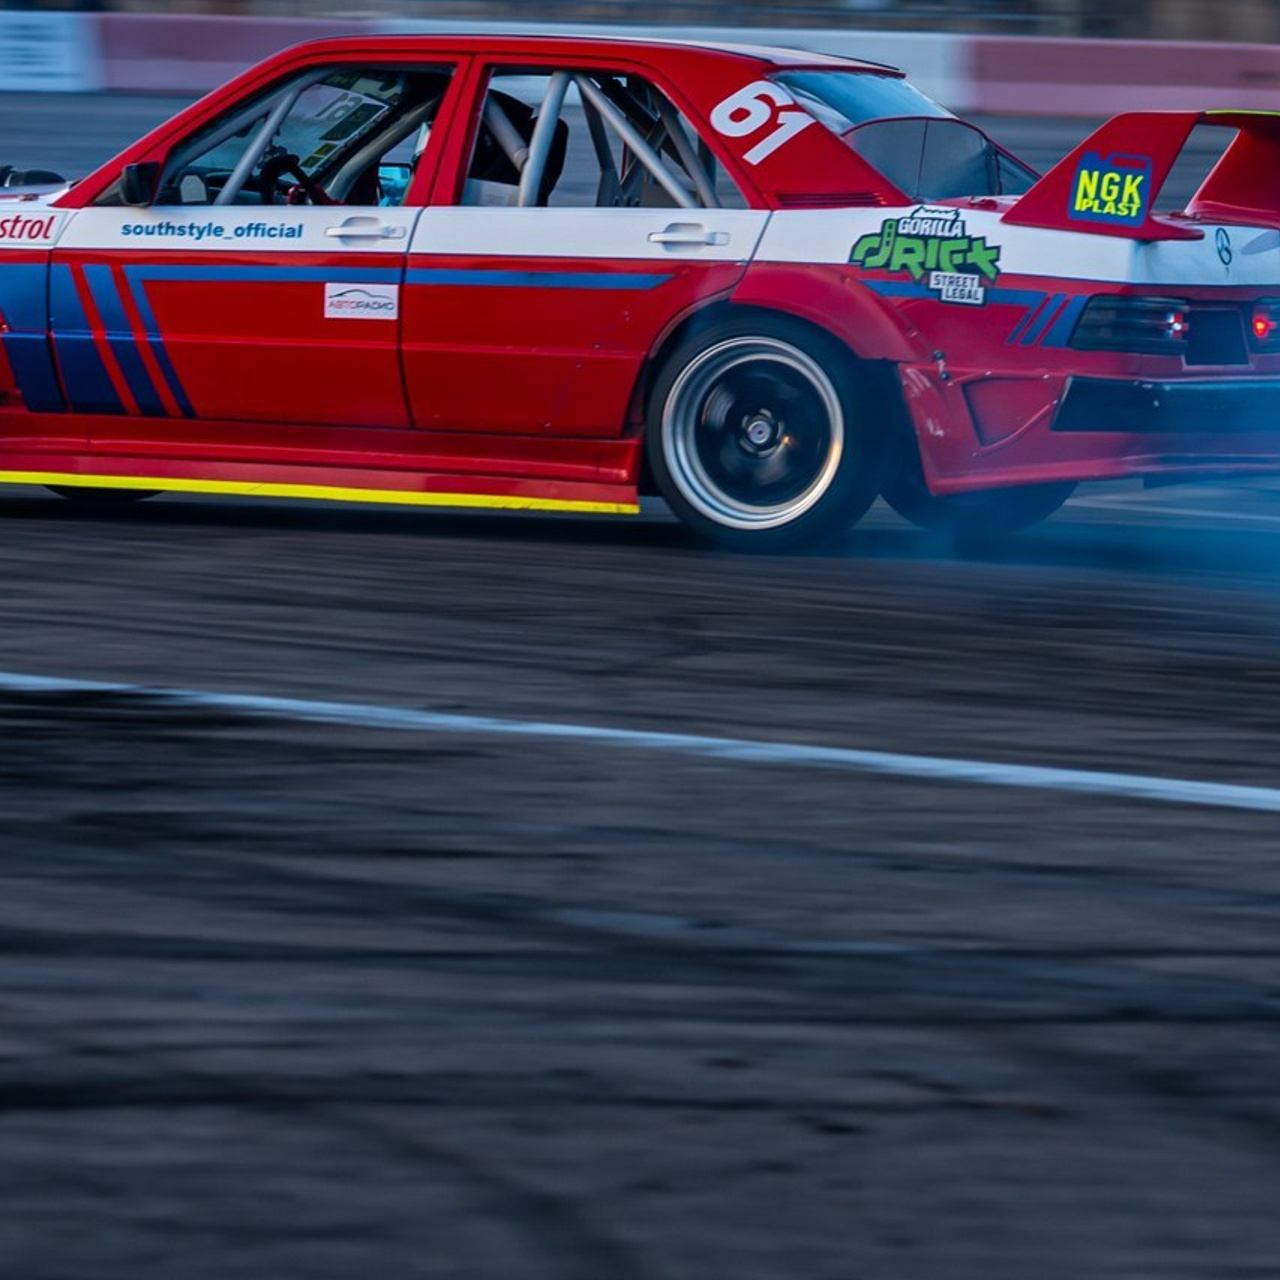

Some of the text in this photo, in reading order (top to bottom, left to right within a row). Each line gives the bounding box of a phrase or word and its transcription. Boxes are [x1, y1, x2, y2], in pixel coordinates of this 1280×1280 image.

[709, 80, 817, 166] 61
[1074, 169, 1144, 211] NGK
[1080, 198, 1141, 217] PLAST
[121, 221, 304, 241] southstyle_official
[897, 218, 964, 237] GORILLA
[933, 274, 977, 288] STREET
[945, 287, 981, 302] LEGAL
